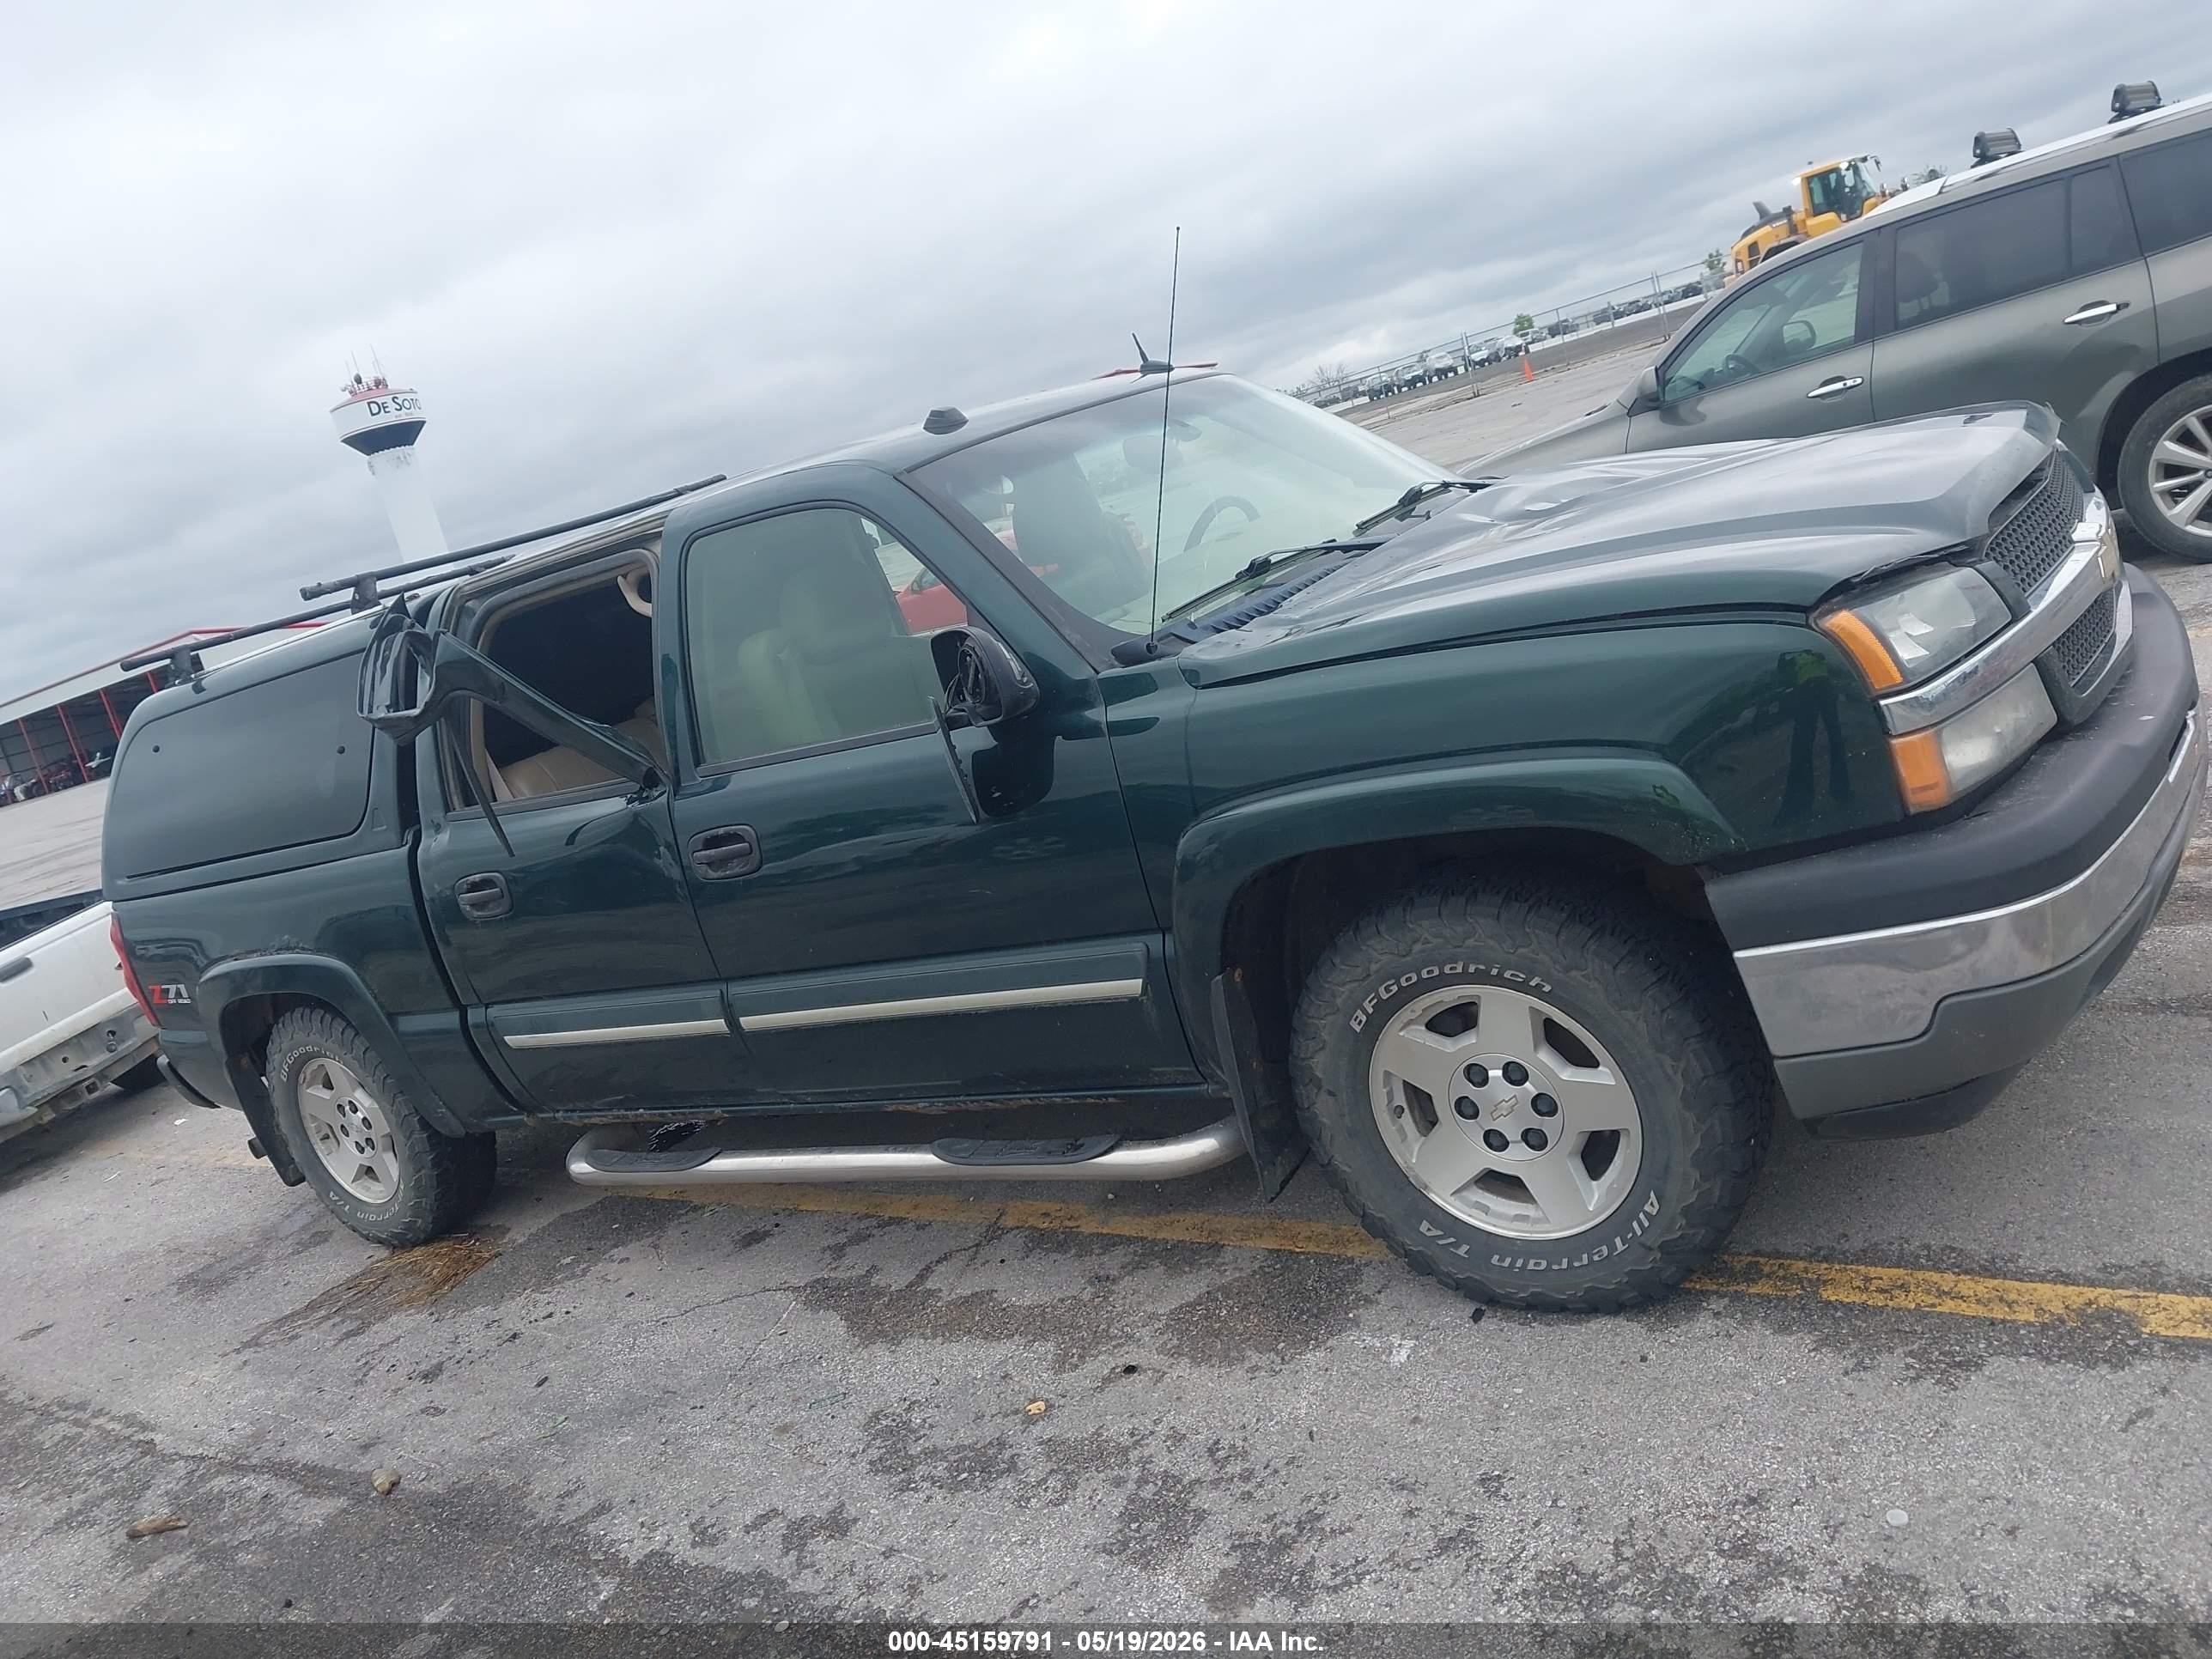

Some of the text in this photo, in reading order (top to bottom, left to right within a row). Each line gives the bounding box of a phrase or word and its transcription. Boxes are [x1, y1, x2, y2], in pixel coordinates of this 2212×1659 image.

[149, 984, 189, 1004] Z71
[1349, 961, 1553, 1034] BFGoodrich
[1419, 1189, 1660, 1272] All-Terrain T/A
